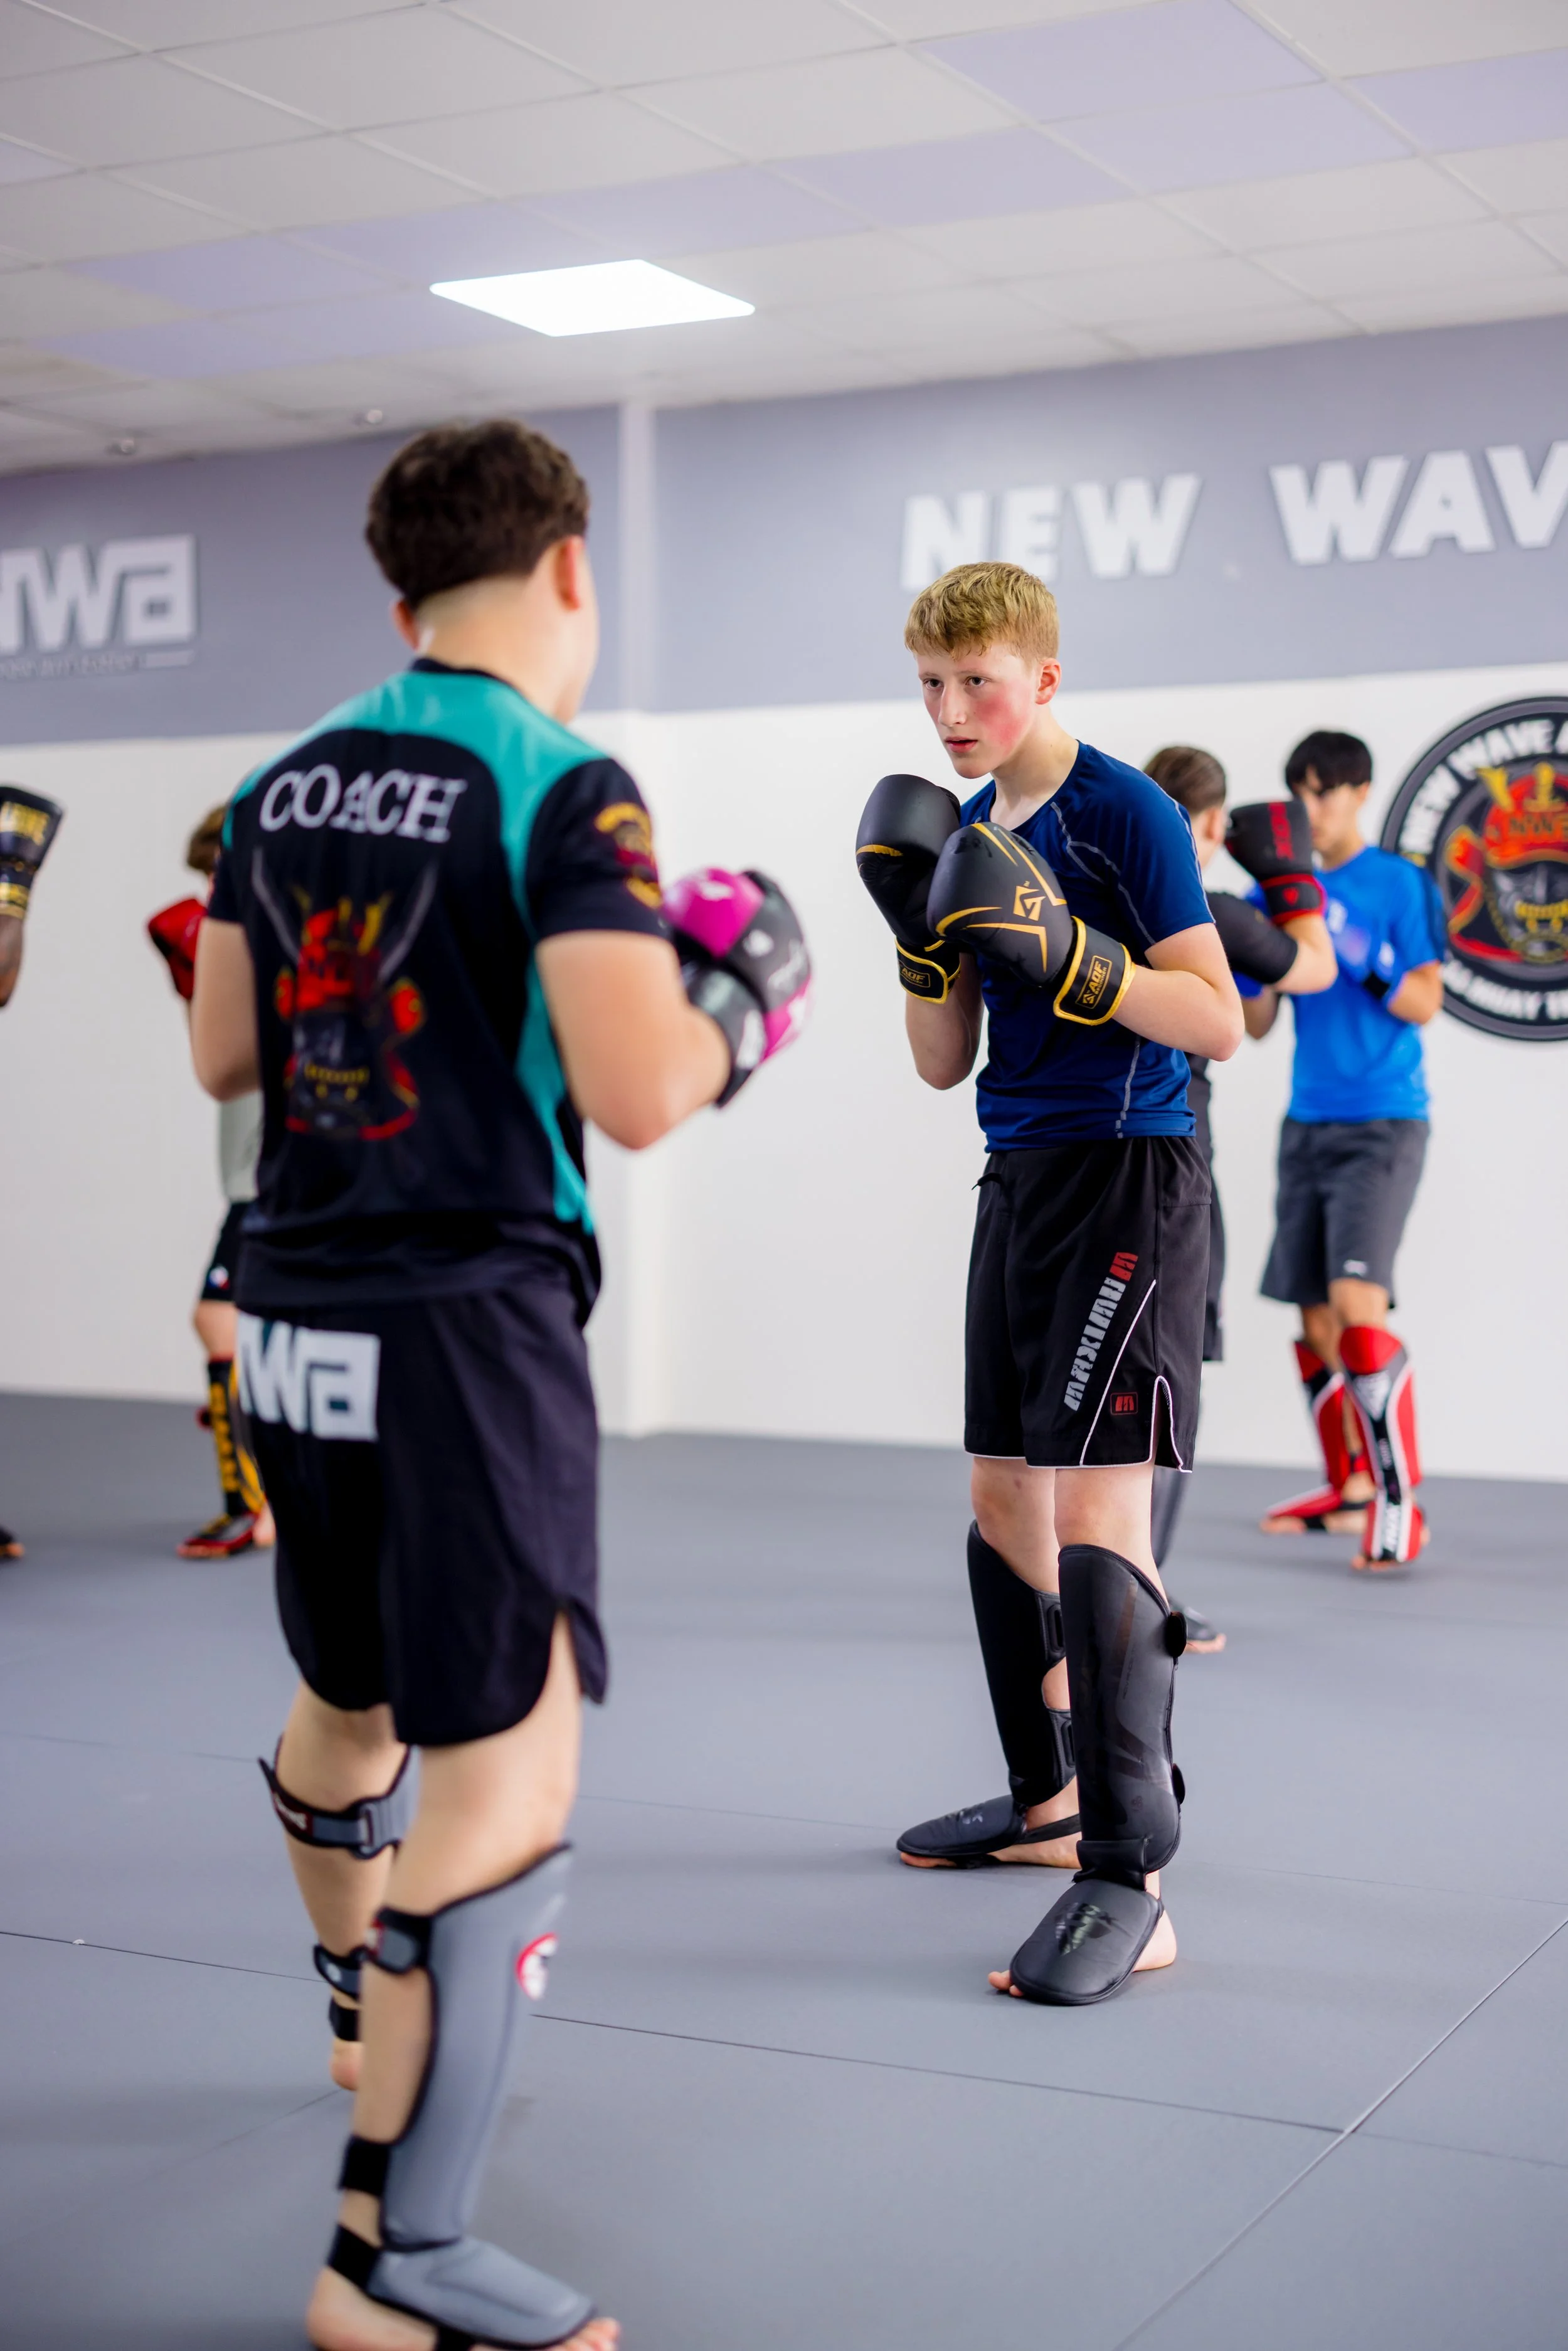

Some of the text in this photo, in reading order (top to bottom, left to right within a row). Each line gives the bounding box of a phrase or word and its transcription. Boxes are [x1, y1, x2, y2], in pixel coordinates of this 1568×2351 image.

[900, 440, 1568, 593] NEW WAV
[259, 763, 467, 843] COACH
[1064, 1252, 1138, 1411] MAXIMUM
